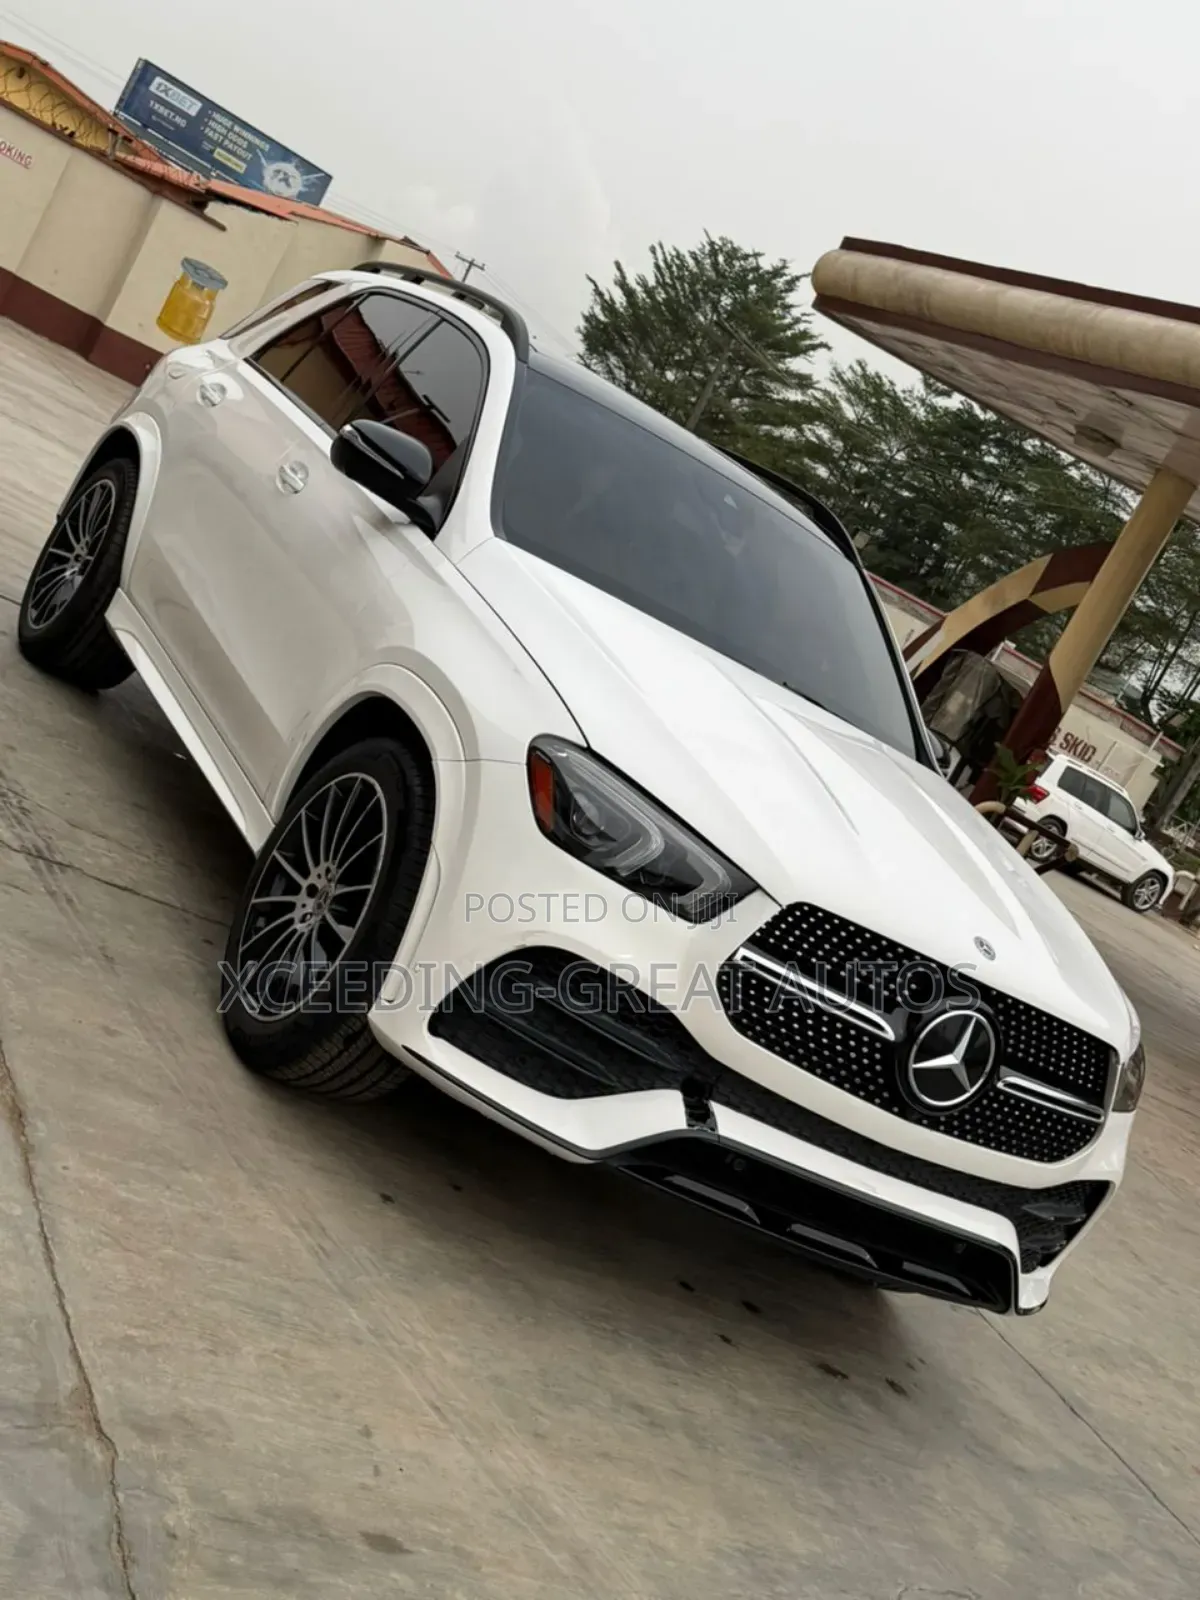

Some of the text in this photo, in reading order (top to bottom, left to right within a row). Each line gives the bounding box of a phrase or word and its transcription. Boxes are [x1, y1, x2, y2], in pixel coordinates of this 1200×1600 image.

[203, 127, 224, 144] FAST
[222, 139, 253, 161] PAYOUT
[1059, 731, 1097, 763] SKID
